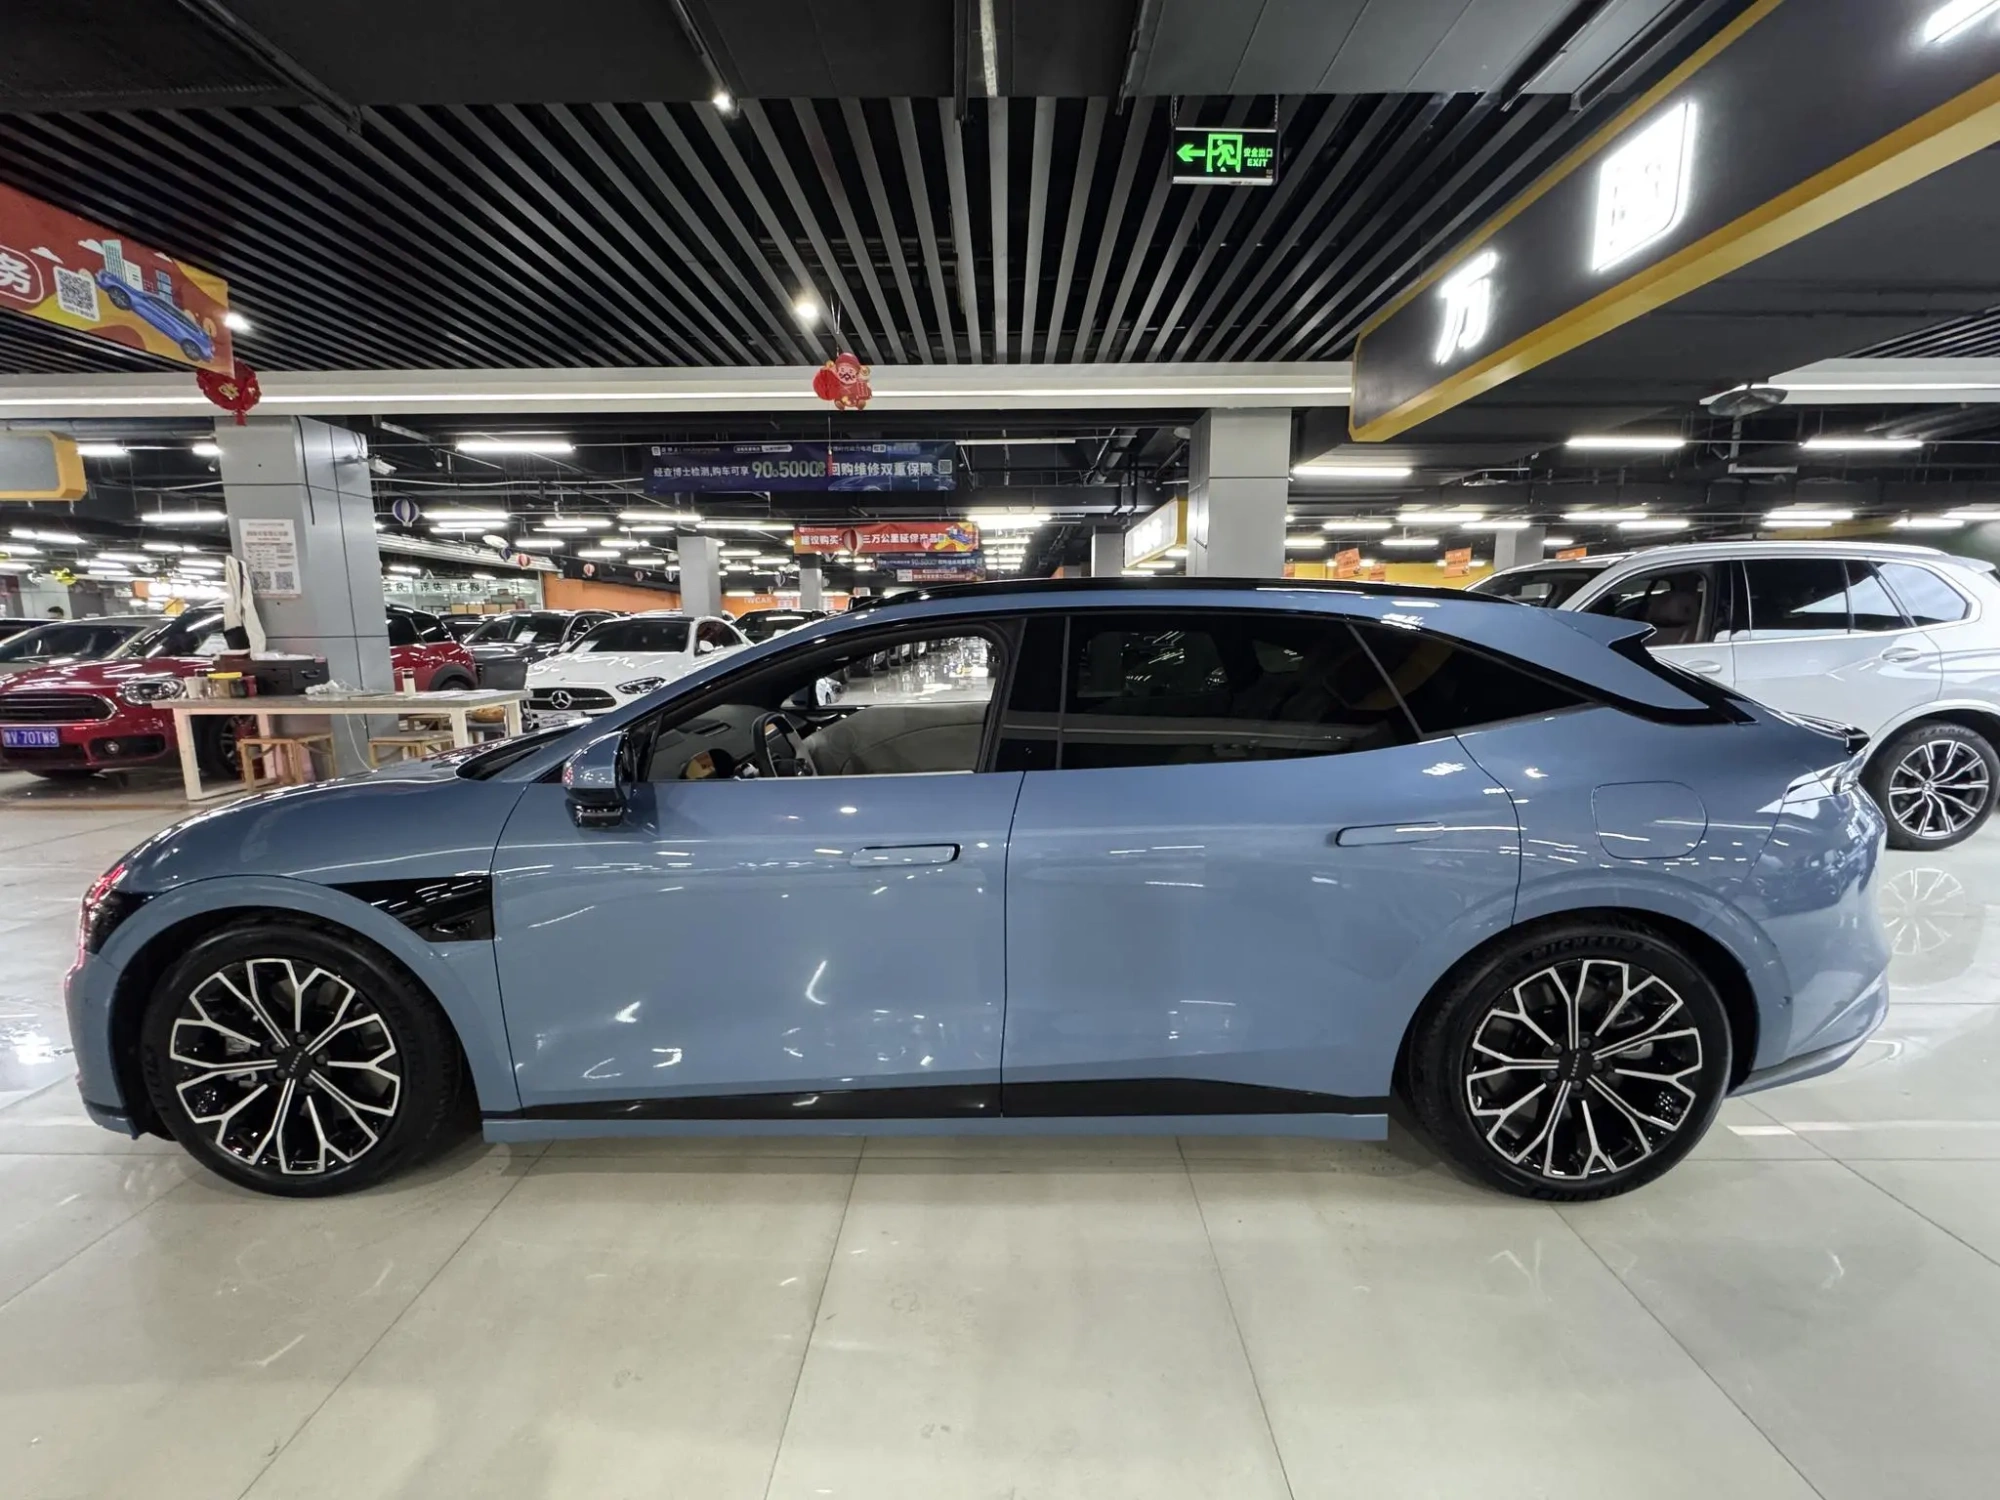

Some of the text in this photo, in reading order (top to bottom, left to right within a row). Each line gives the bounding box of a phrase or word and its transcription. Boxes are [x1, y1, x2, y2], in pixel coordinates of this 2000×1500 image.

[1243, 147, 1273, 158] 安全出口
[1247, 158, 1268, 167] EXIT
[1531, 936, 1637, 959] MICHELIN
